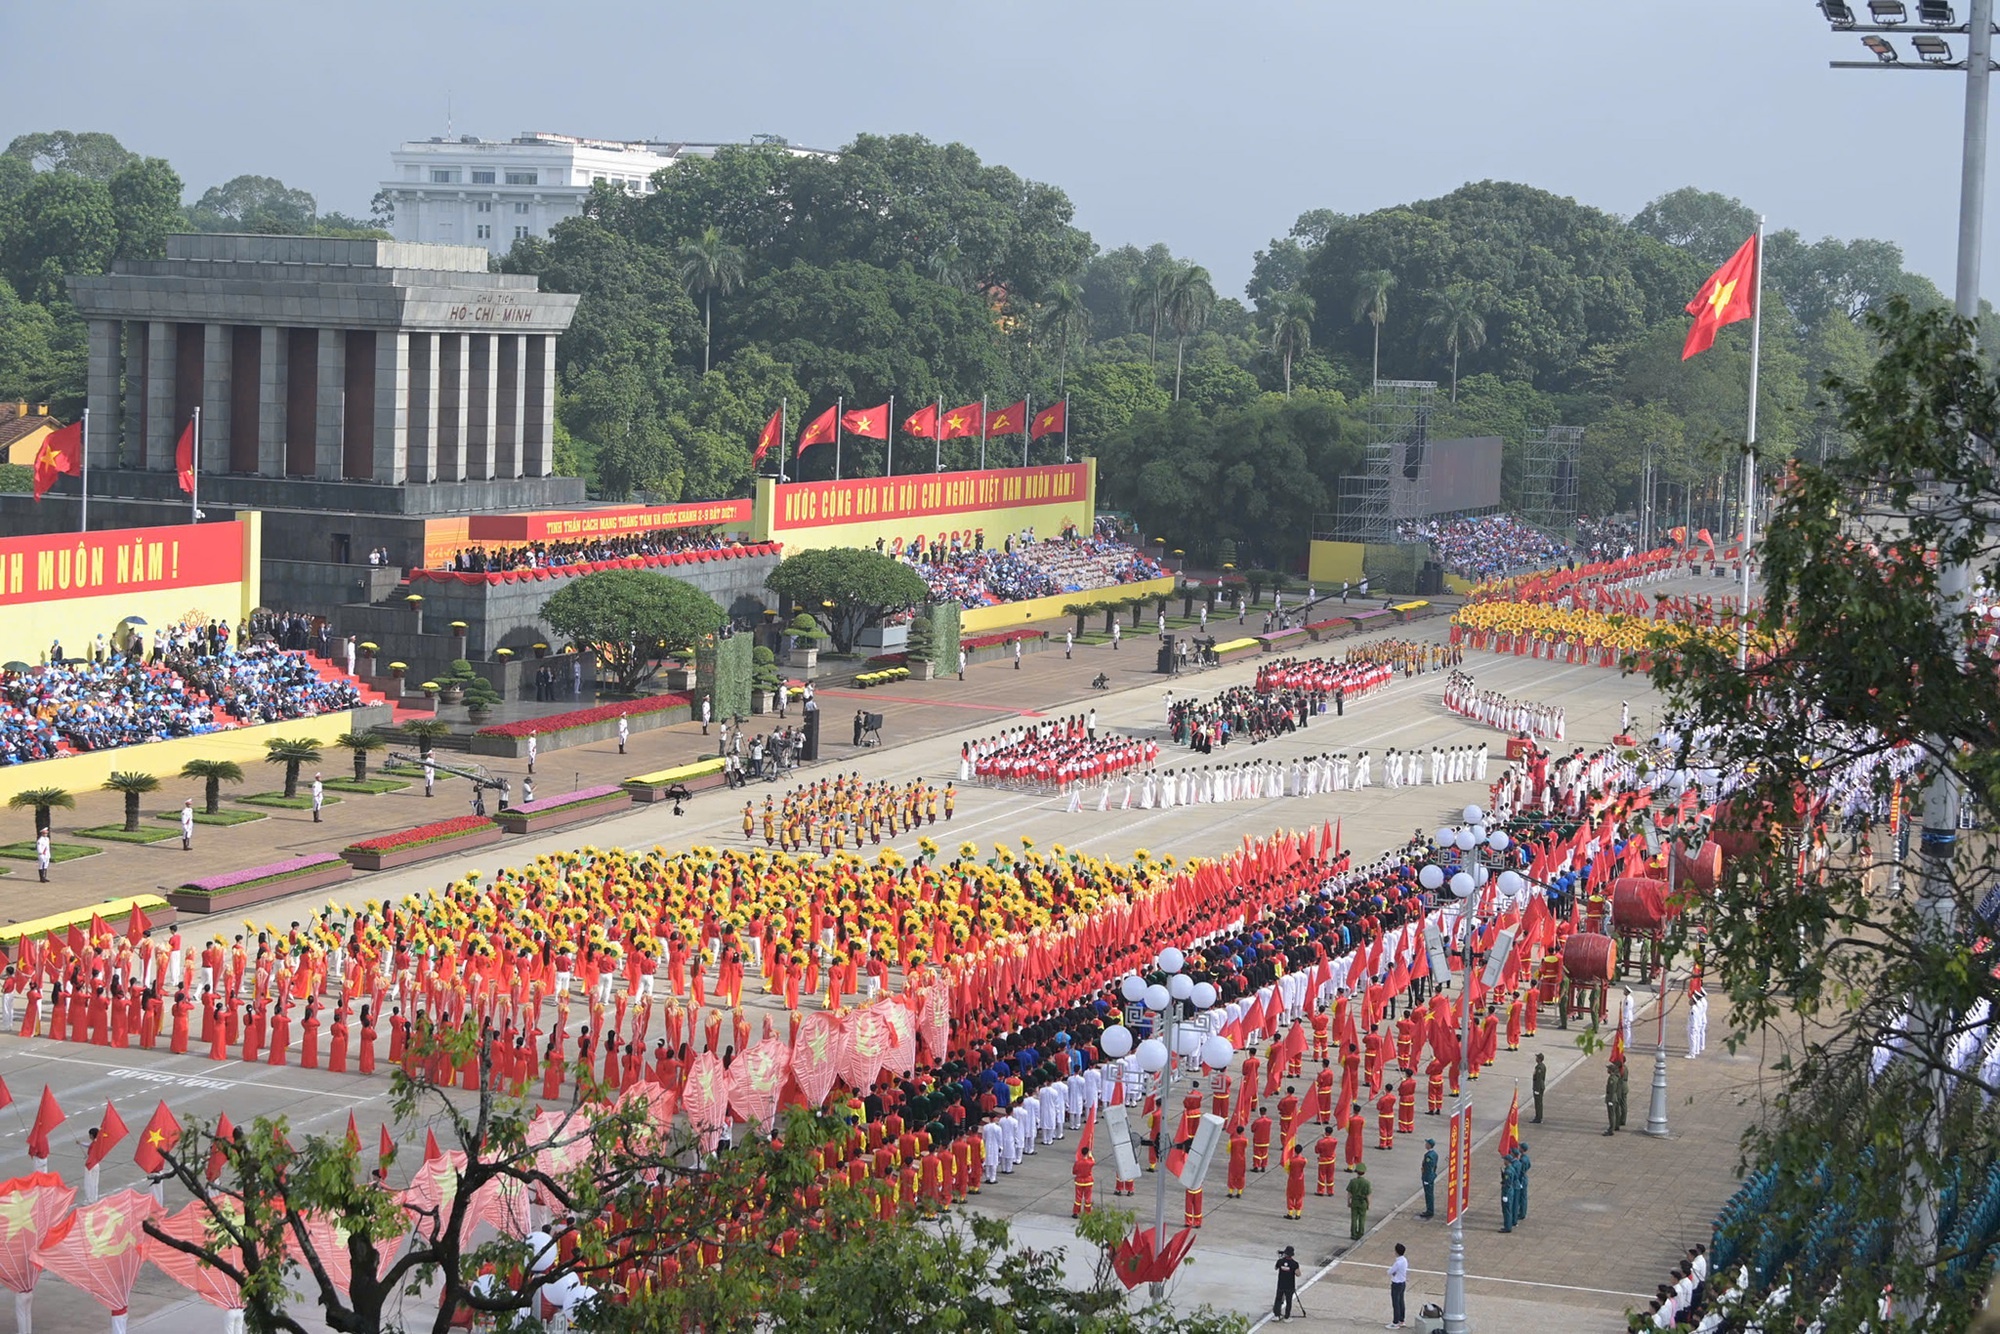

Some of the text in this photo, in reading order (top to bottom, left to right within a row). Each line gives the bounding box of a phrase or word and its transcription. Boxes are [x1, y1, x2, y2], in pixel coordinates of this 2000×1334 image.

[698, 509, 709, 521] 2-9
[821, 486, 852, 522] CỘNG
[856, 484, 877, 515] HÒA
[881, 482, 895, 512] XÃ
[899, 480, 917, 515] HỘI
[921, 476, 942, 509] CHỦ
[945, 476, 975, 507] NGHĨA
[979, 475, 1000, 507] VIỆT
[1003, 476, 1022, 501] NAM
[1025, 470, 1050, 499] MUÔN
[37, 541, 104, 591] MUÔN
